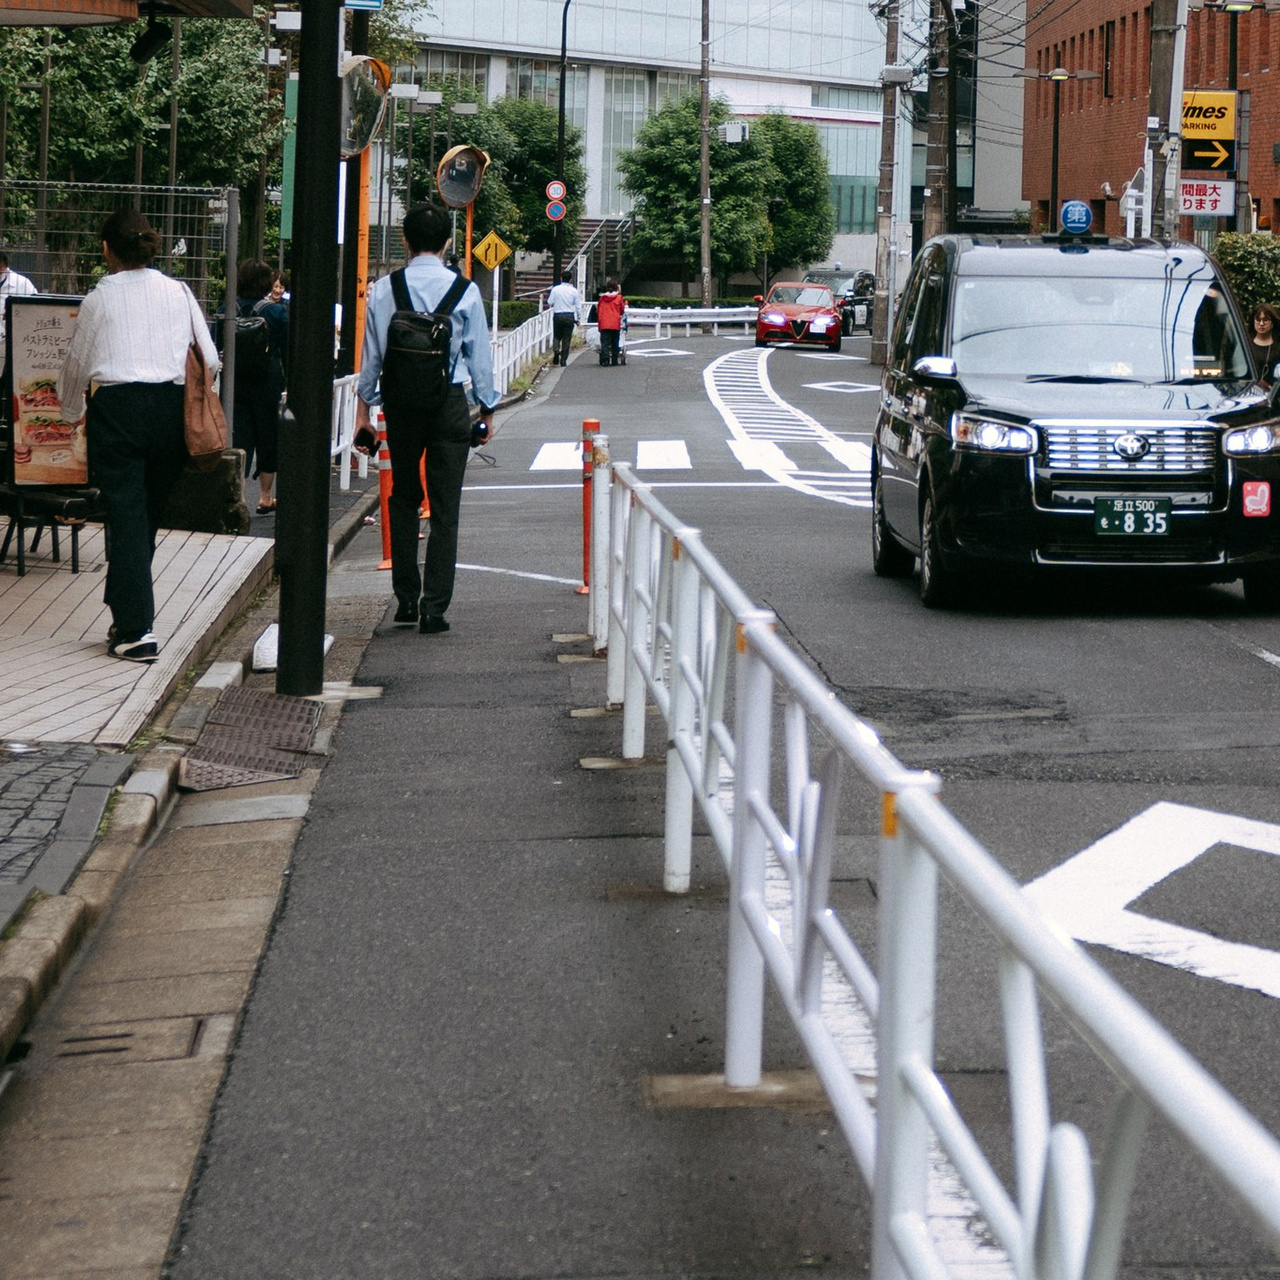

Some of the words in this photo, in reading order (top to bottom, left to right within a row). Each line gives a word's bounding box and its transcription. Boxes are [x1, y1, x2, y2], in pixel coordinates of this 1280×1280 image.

[1182, 101, 1228, 119] imes
[1181, 122, 1217, 131] ARKING
[550, 186, 562, 196] 30
